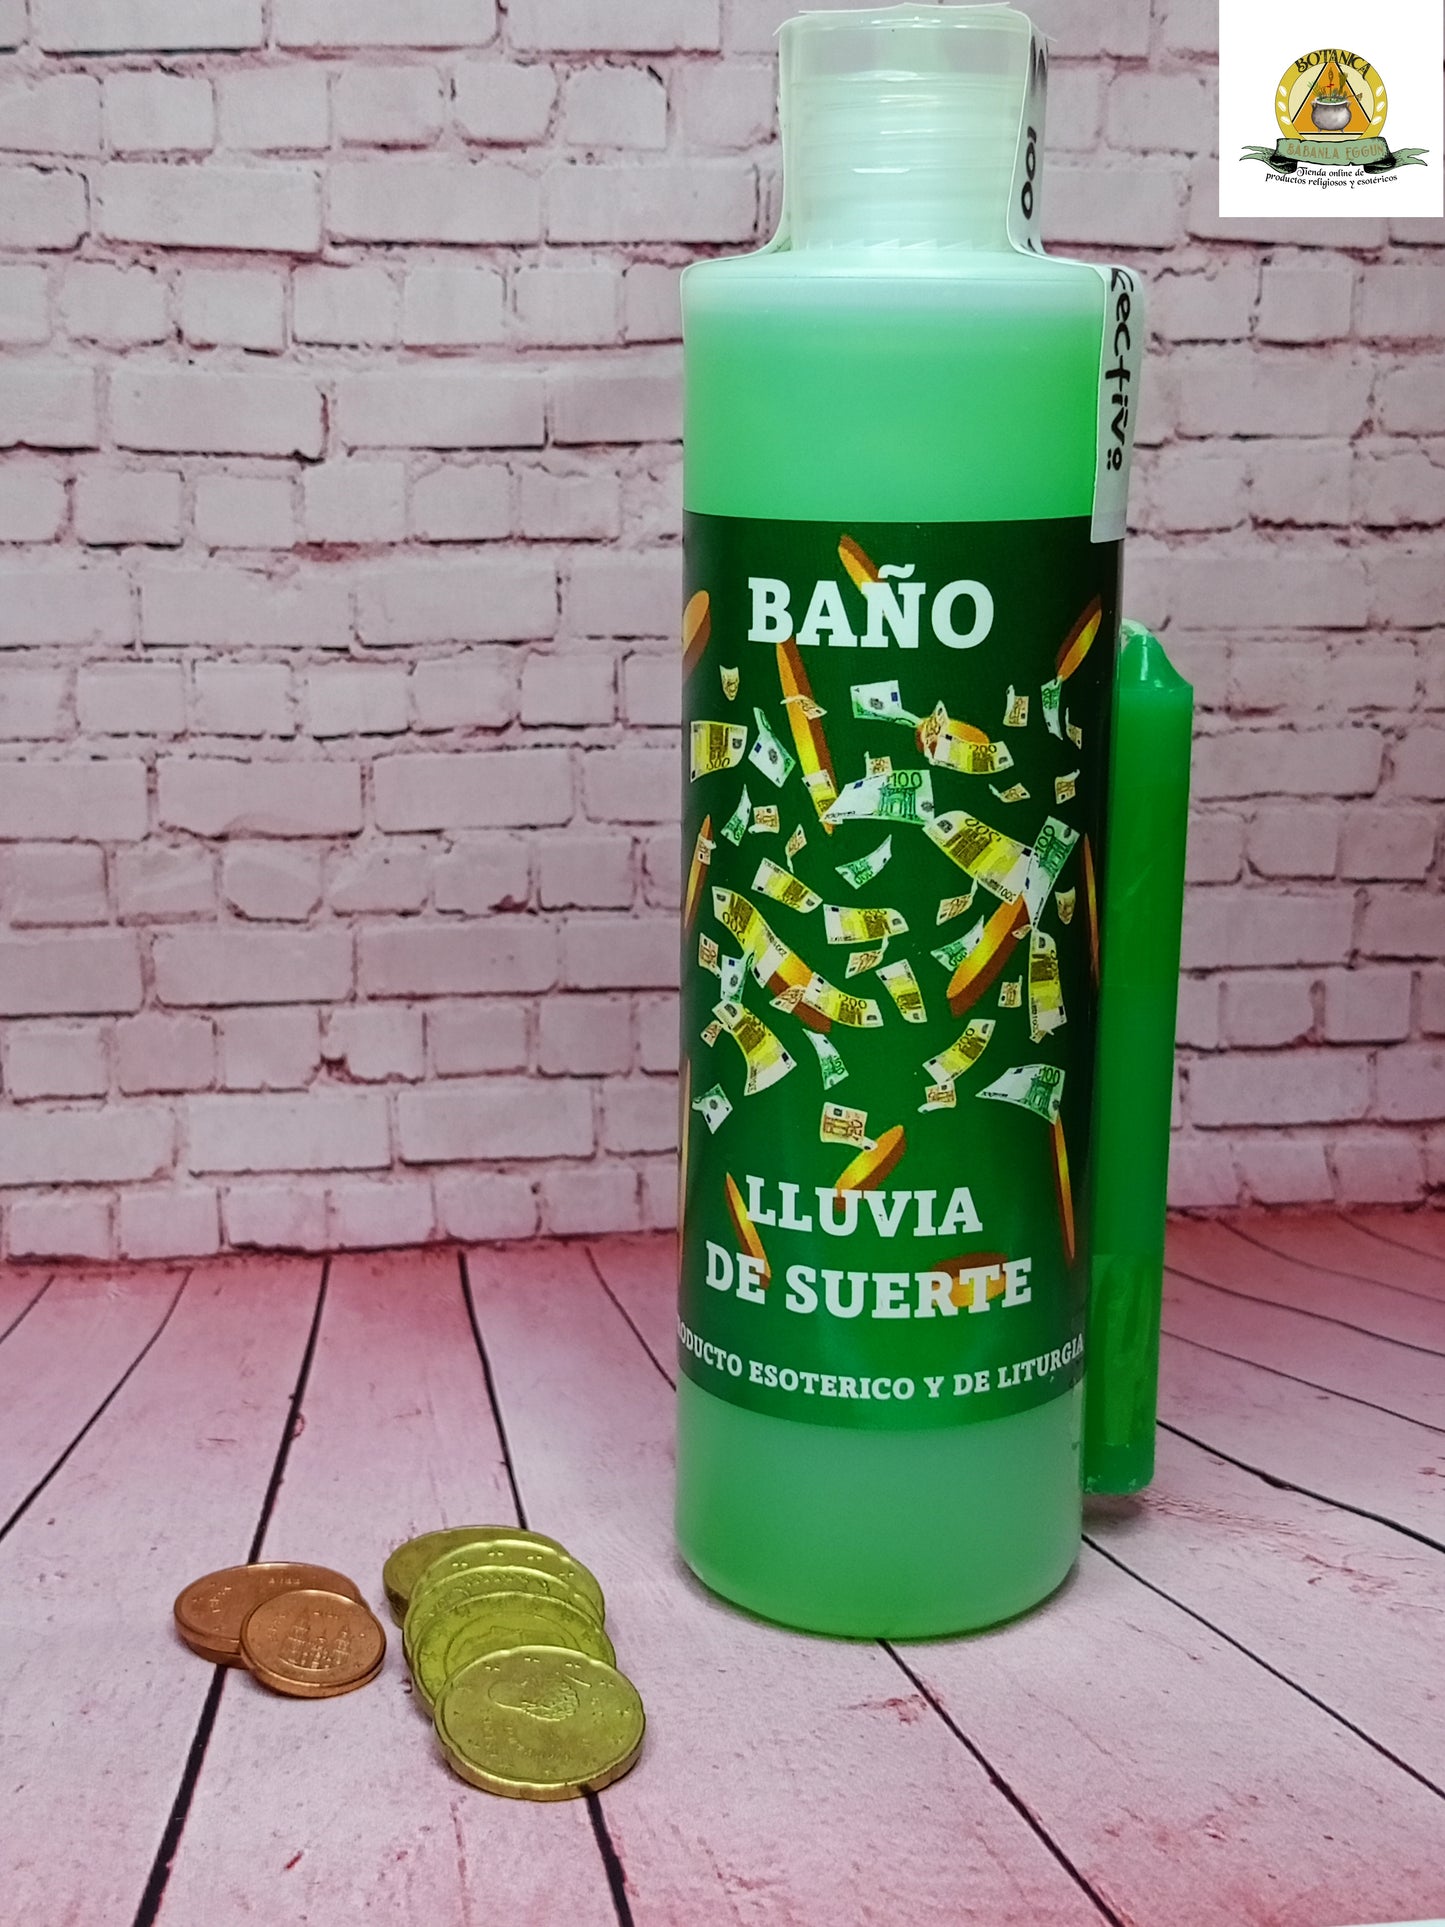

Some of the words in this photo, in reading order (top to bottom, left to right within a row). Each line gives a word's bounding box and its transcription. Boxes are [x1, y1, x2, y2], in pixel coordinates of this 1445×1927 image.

[748, 564, 994, 649] BAÑO
[745, 1174, 983, 1237] LLUVIA
[706, 1240, 766, 1304] DE
[785, 1257, 1032, 1319] SUERTE
[677, 1319, 742, 1376] ODUCTO
[749, 1360, 914, 1400] ESOTERICO
[924, 1376, 944, 1398] Y
[953, 1370, 990, 1396] DE
[997, 1332, 1084, 1389] LITURGIA
